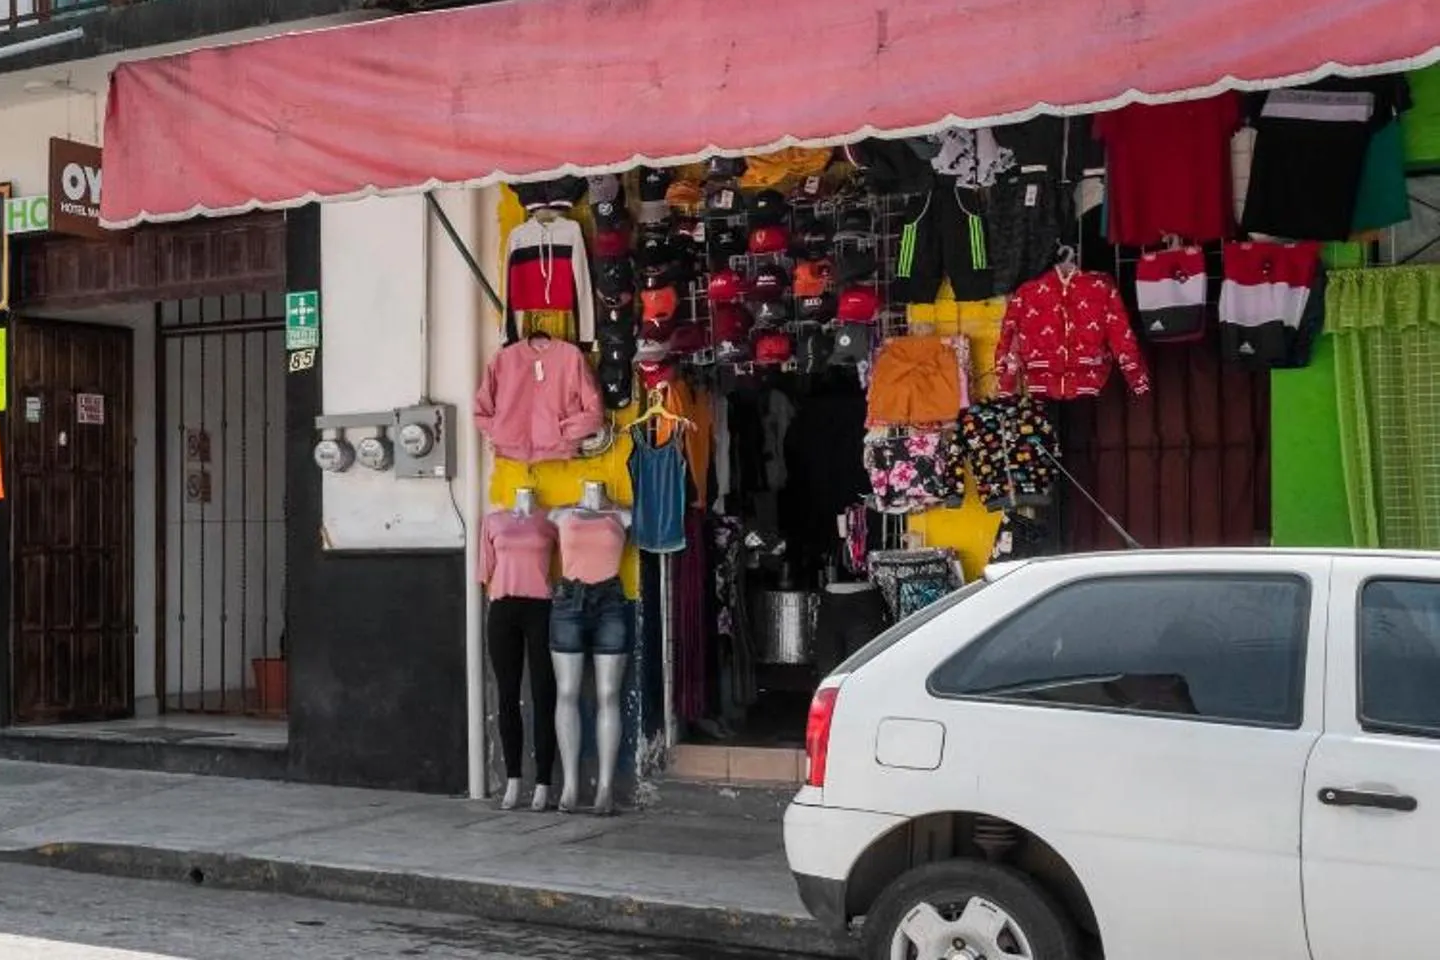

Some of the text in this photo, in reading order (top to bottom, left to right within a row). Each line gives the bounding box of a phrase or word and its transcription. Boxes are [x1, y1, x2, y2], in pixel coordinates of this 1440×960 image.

[62, 162, 101, 205] OY
[8, 196, 48, 231] HO
[60, 201, 87, 216] HOTEL
